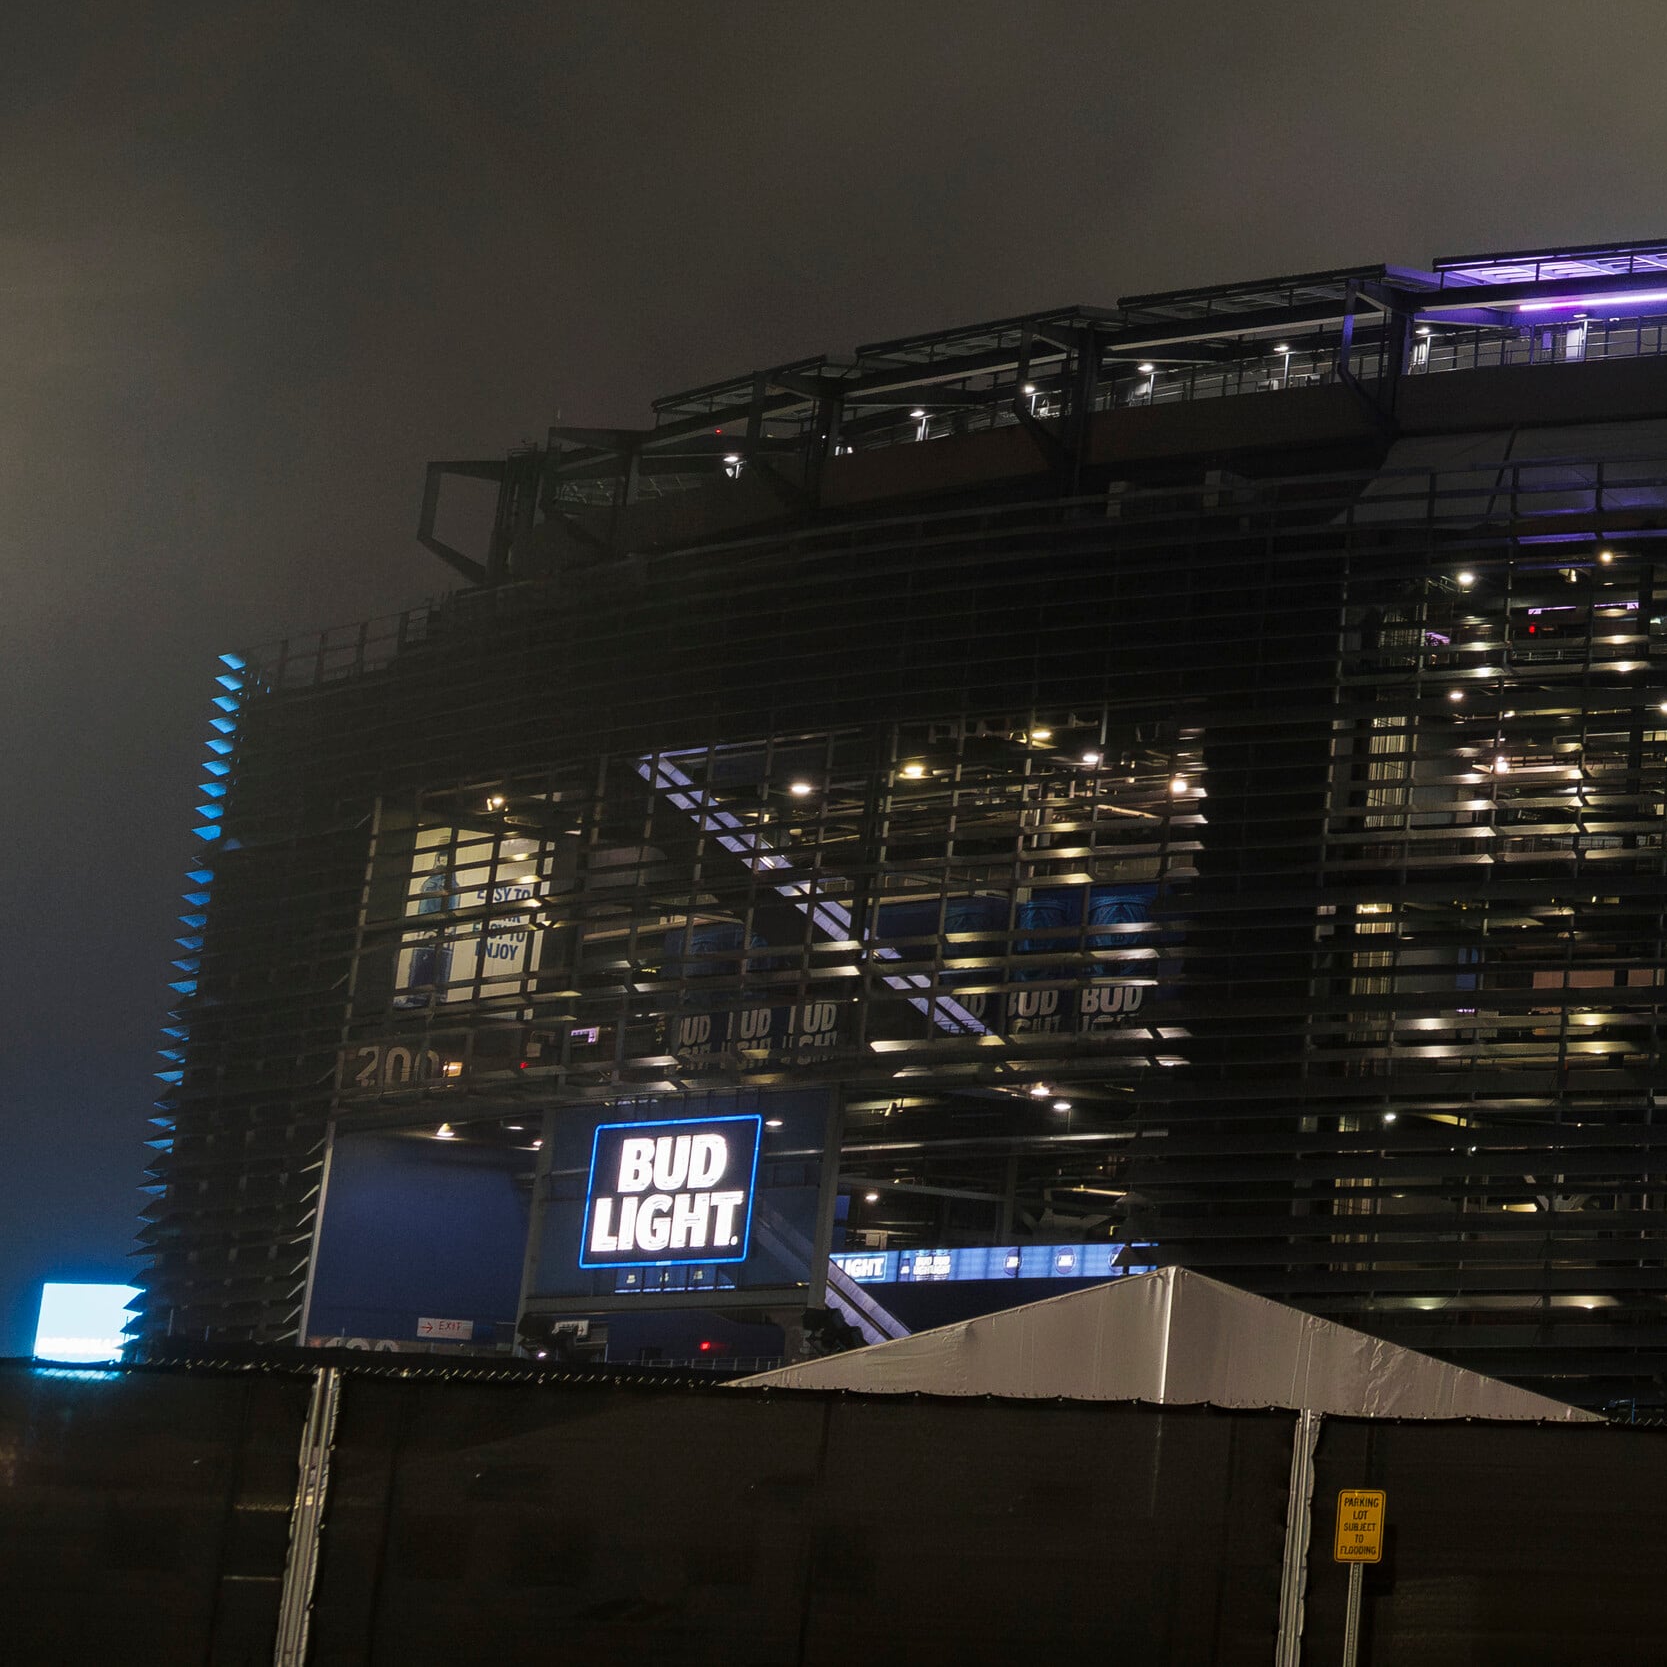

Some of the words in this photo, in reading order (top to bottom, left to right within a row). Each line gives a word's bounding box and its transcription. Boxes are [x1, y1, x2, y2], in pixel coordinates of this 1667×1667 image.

[477, 887, 512, 902] ESY
[1081, 987, 1143, 1014] BUD
[679, 1014, 712, 1046] UD
[617, 1134, 727, 1193] BUD
[1344, 1497, 1379, 1507] PARKING
[1352, 1510, 1368, 1520] LOT
[1343, 1523, 1376, 1531] SUBJECT
[1355, 1534, 1364, 1543] TO
[1340, 1546, 1376, 1555] FLOODING
